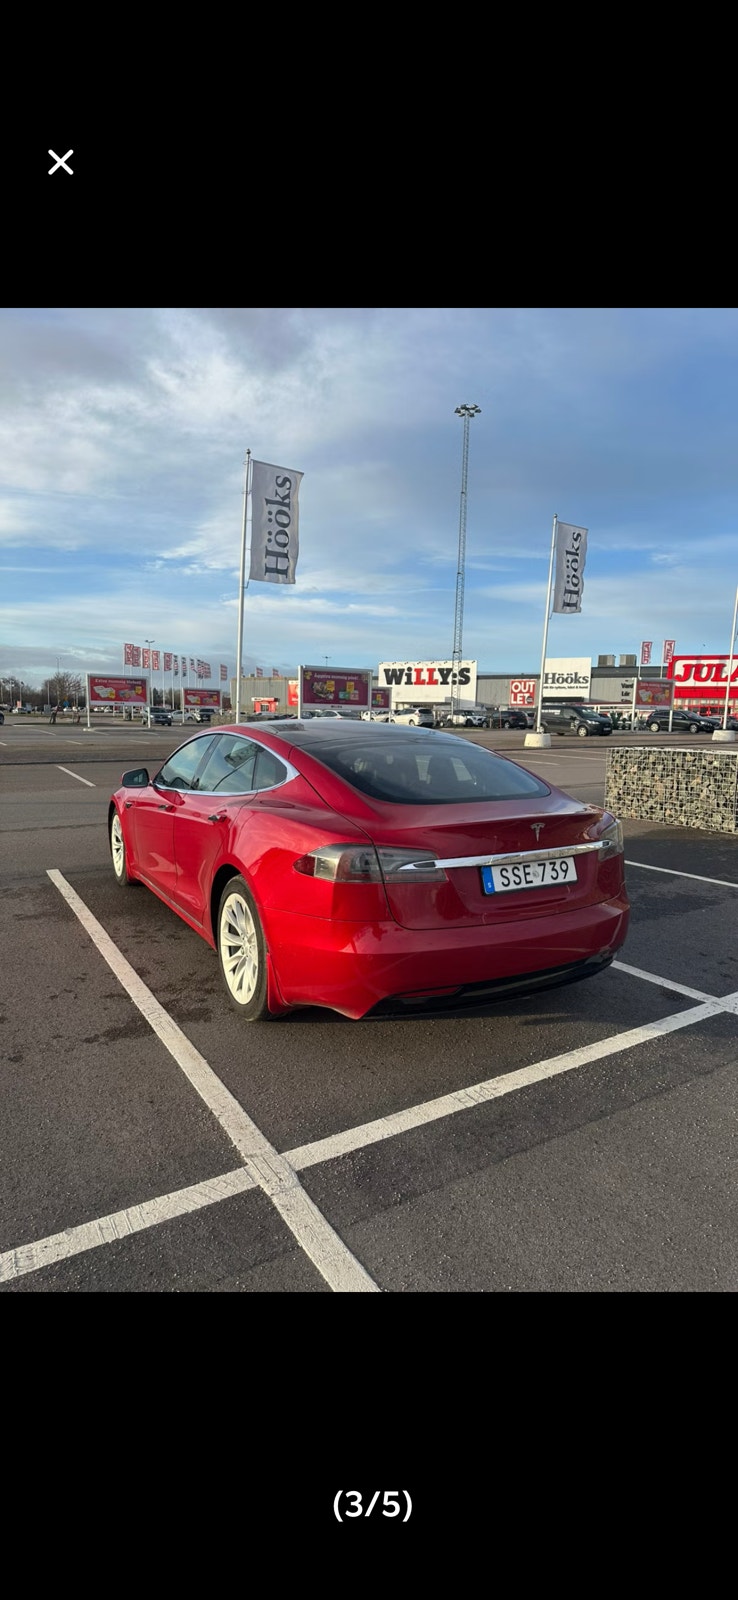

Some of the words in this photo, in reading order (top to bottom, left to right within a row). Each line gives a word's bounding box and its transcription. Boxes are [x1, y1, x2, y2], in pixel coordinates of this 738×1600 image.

[264, 475, 292, 578] Hööks
[562, 532, 582, 609] Hööks
[511, 682, 535, 693] OUT
[543, 672, 589, 684] Hööks
[511, 693, 531, 704] LET
[500, 864, 534, 887] SSE
[538, 861, 569, 882] 739
